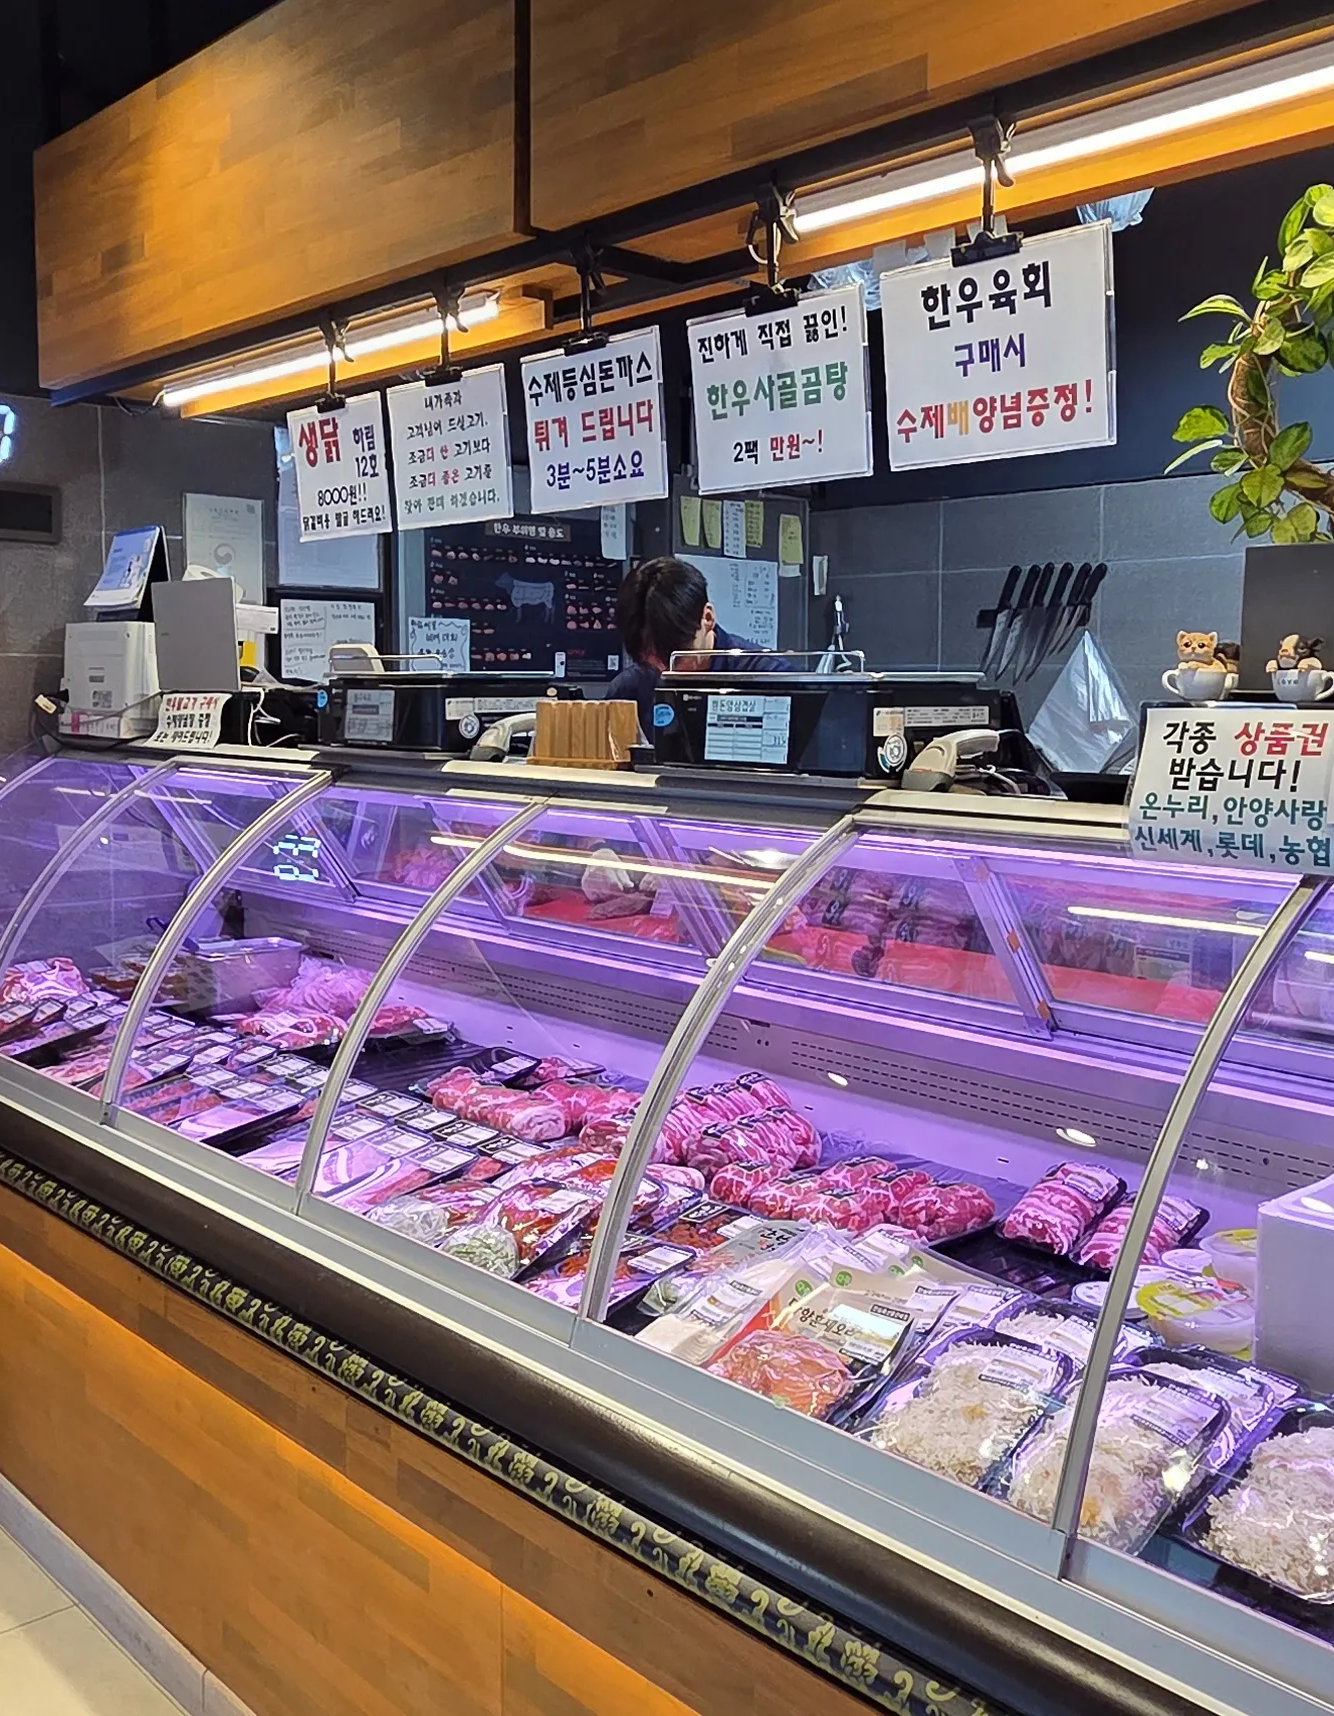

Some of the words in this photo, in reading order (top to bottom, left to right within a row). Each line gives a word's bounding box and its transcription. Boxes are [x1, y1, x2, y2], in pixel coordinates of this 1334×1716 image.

[921, 260, 1053, 331] 한우육회
[697, 332, 748, 364] 진하게
[757, 320, 792, 351] 직접
[802, 305, 849, 345] 끓인!
[954, 333, 1027, 377] 구매시
[527, 355, 654, 408] 수제등심돈까스
[706, 360, 849, 420] 한우사골곰탕
[533, 415, 569, 452] 튀겨
[580, 399, 654, 443] 드립니다
[896, 378, 1094, 446] 수제배양념증정!
[299, 417, 341, 468] 생닭
[352, 424, 376, 453] 하림
[453, 437, 491, 458] 고기보다
[732, 437, 759, 465] 2팩
[769, 430, 824, 462] 만원~!
[355, 453, 380, 478] 12호
[464, 463, 492, 481] 고기를
[545, 449, 646, 489] 3분~5분소요
[317, 482, 367, 507] 8000원!!
[450, 488, 500, 509] 하겠습니다.
[1163, 721, 1217, 755] 각종
[1234, 721, 1329, 758] 상품권
[1168, 758, 1300, 793] 받습니다!
